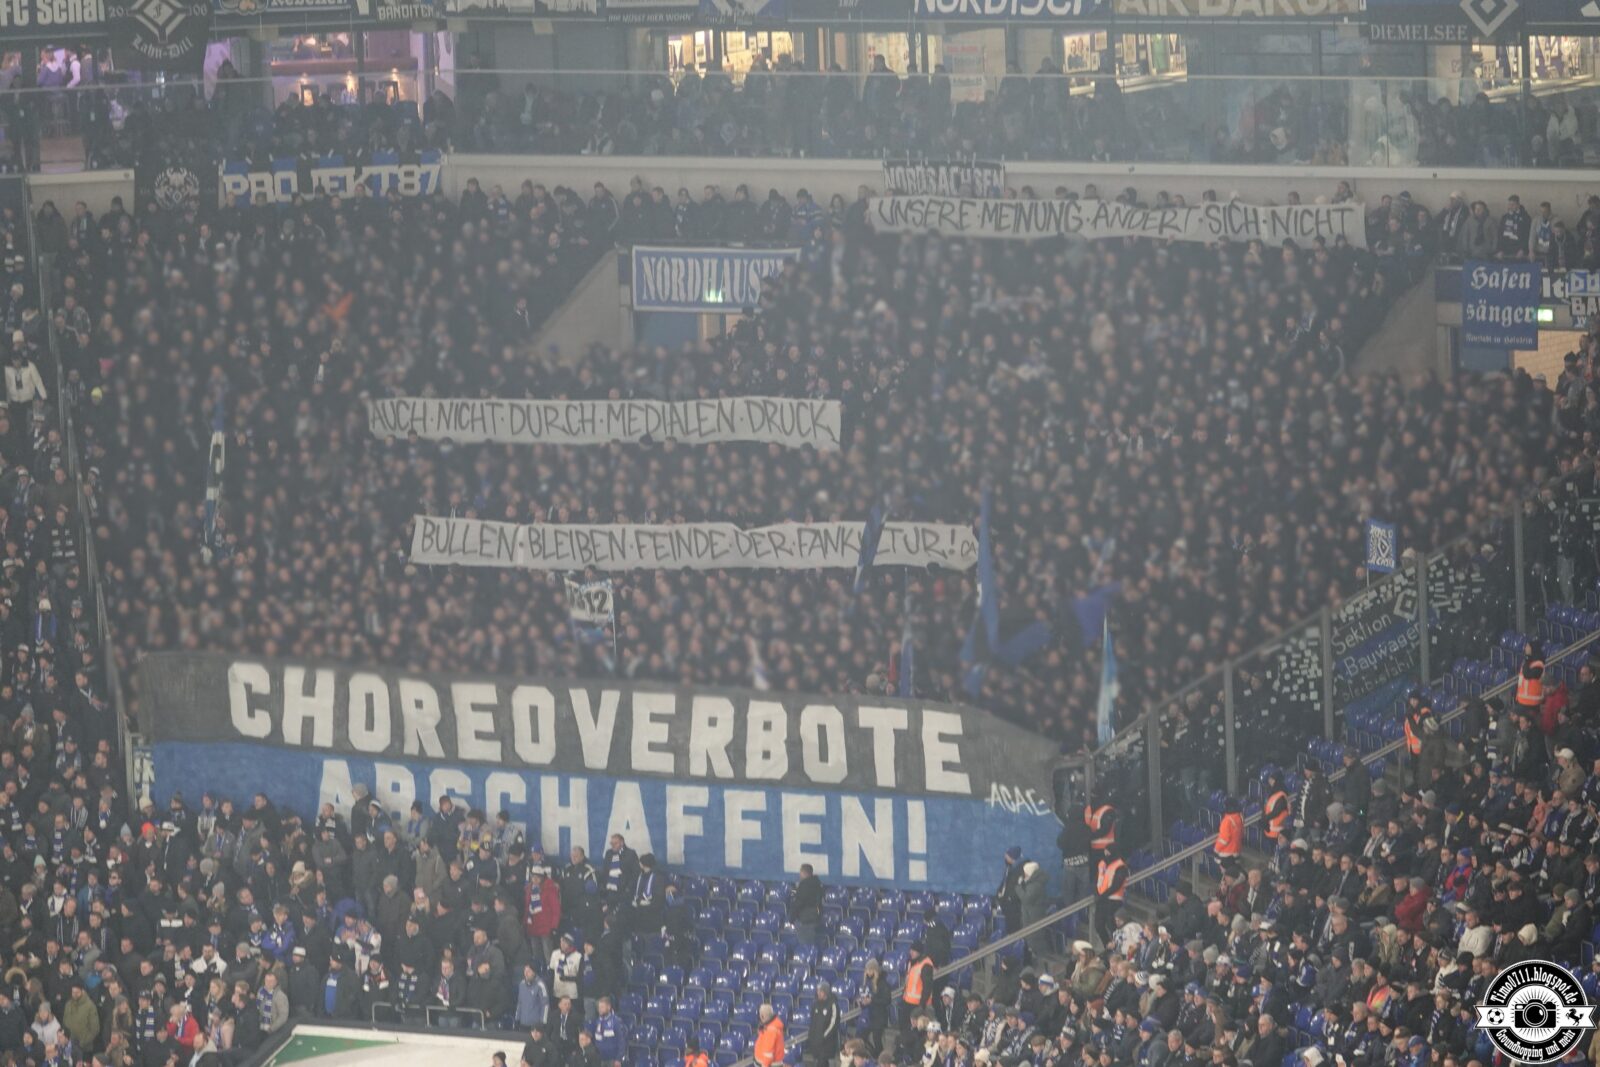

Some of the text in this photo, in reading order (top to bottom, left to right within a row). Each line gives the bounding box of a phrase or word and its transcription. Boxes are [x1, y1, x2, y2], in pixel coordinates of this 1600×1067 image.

[1370, 24, 1468, 41] DIEMELSEE
[878, 199, 976, 231] UNSERE
[980, 201, 1083, 233] MEINUNG
[1205, 202, 1260, 235] SICH
[1271, 206, 1354, 238] NICHT
[1470, 266, 1531, 292] Hafen
[370, 398, 840, 444] AUCH NICHT DURCH MEDIALEN DRUCK
[421, 518, 520, 561] BULLEN
[528, 526, 626, 564] BLEIBEN
[634, 526, 727, 561] FEINDE
[734, 529, 793, 563] DER
[228, 661, 972, 794] CHOREOVERBOTE
